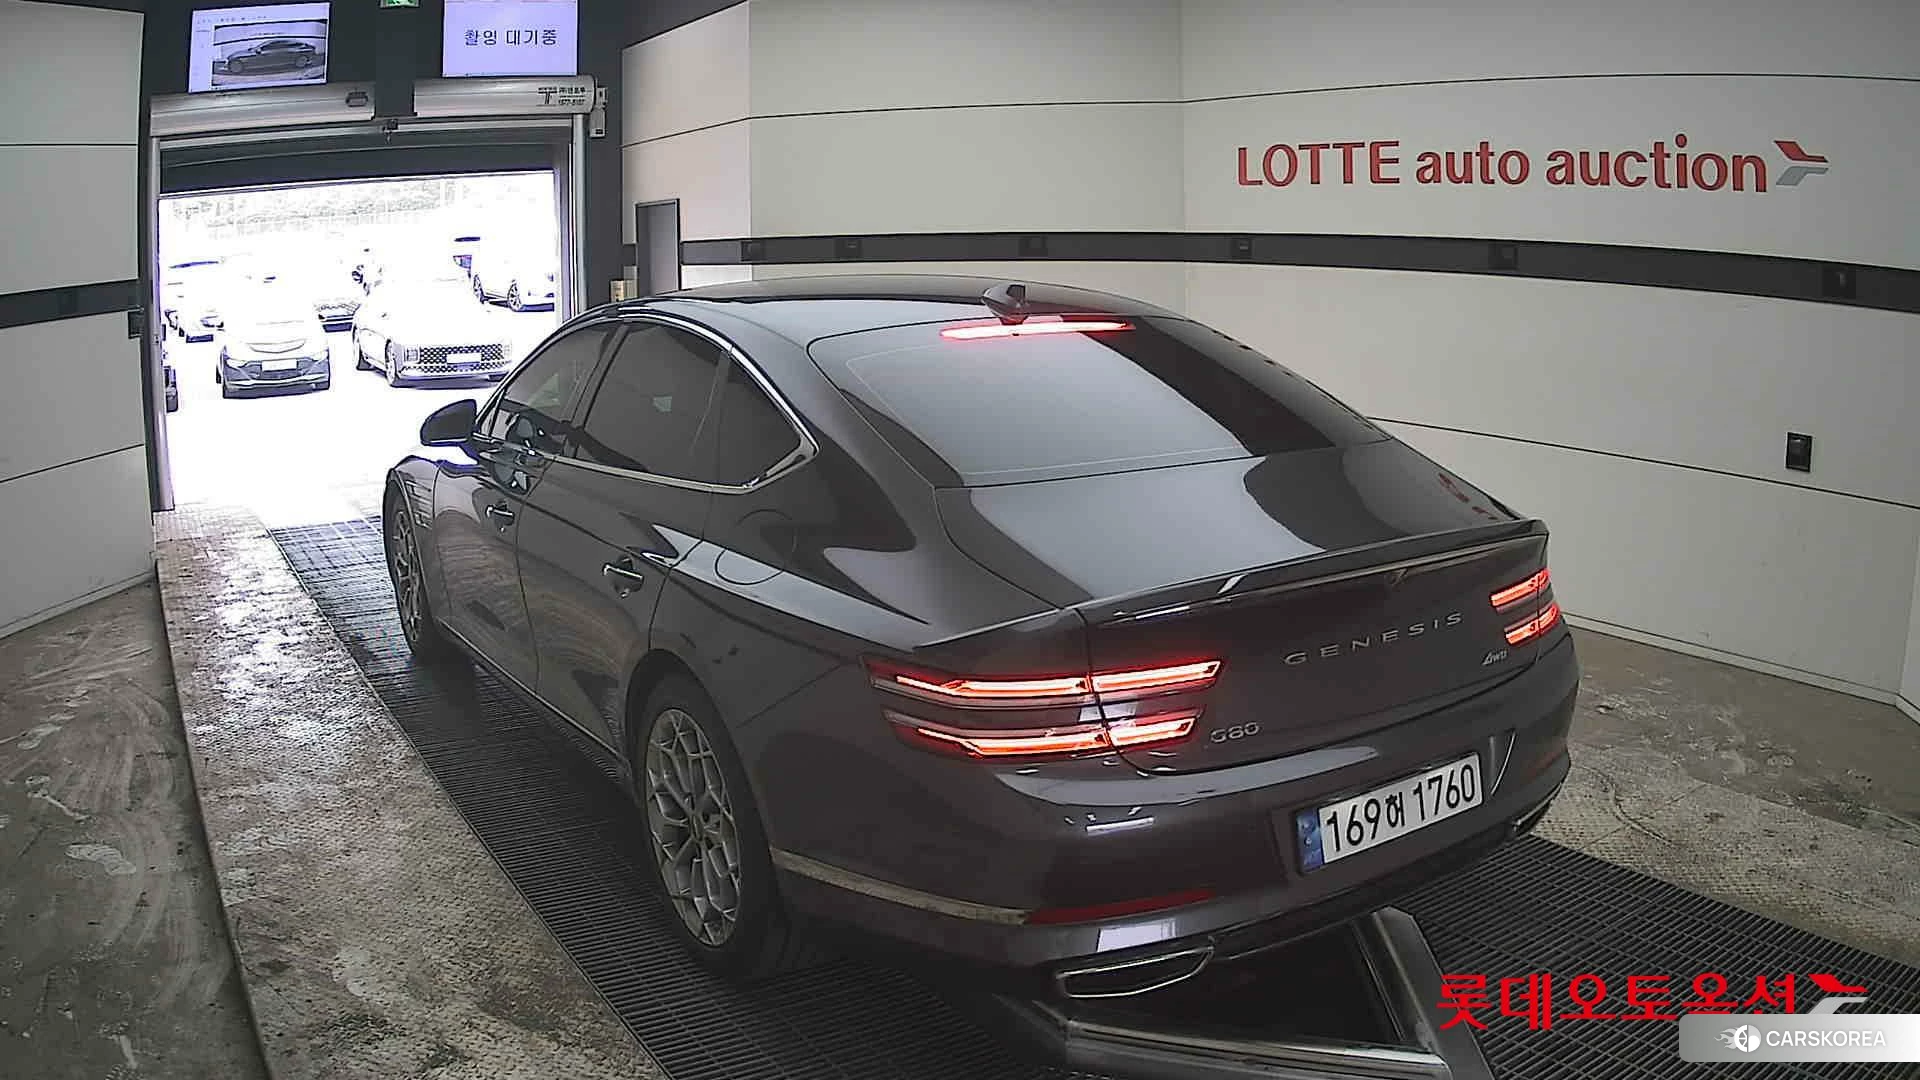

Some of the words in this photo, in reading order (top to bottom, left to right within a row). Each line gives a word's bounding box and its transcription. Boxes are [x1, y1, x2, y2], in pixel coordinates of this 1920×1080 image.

[505, 29, 558, 46] 대기중
[1237, 140, 1400, 187] LOTTE
[1416, 140, 1530, 186] auto
[1546, 133, 1767, 194] auction
[1283, 612, 1464, 666] GENESIS
[1211, 722, 1259, 743] G80
[1326, 790, 1406, 853] 169허
[1412, 764, 1476, 822] 1760
